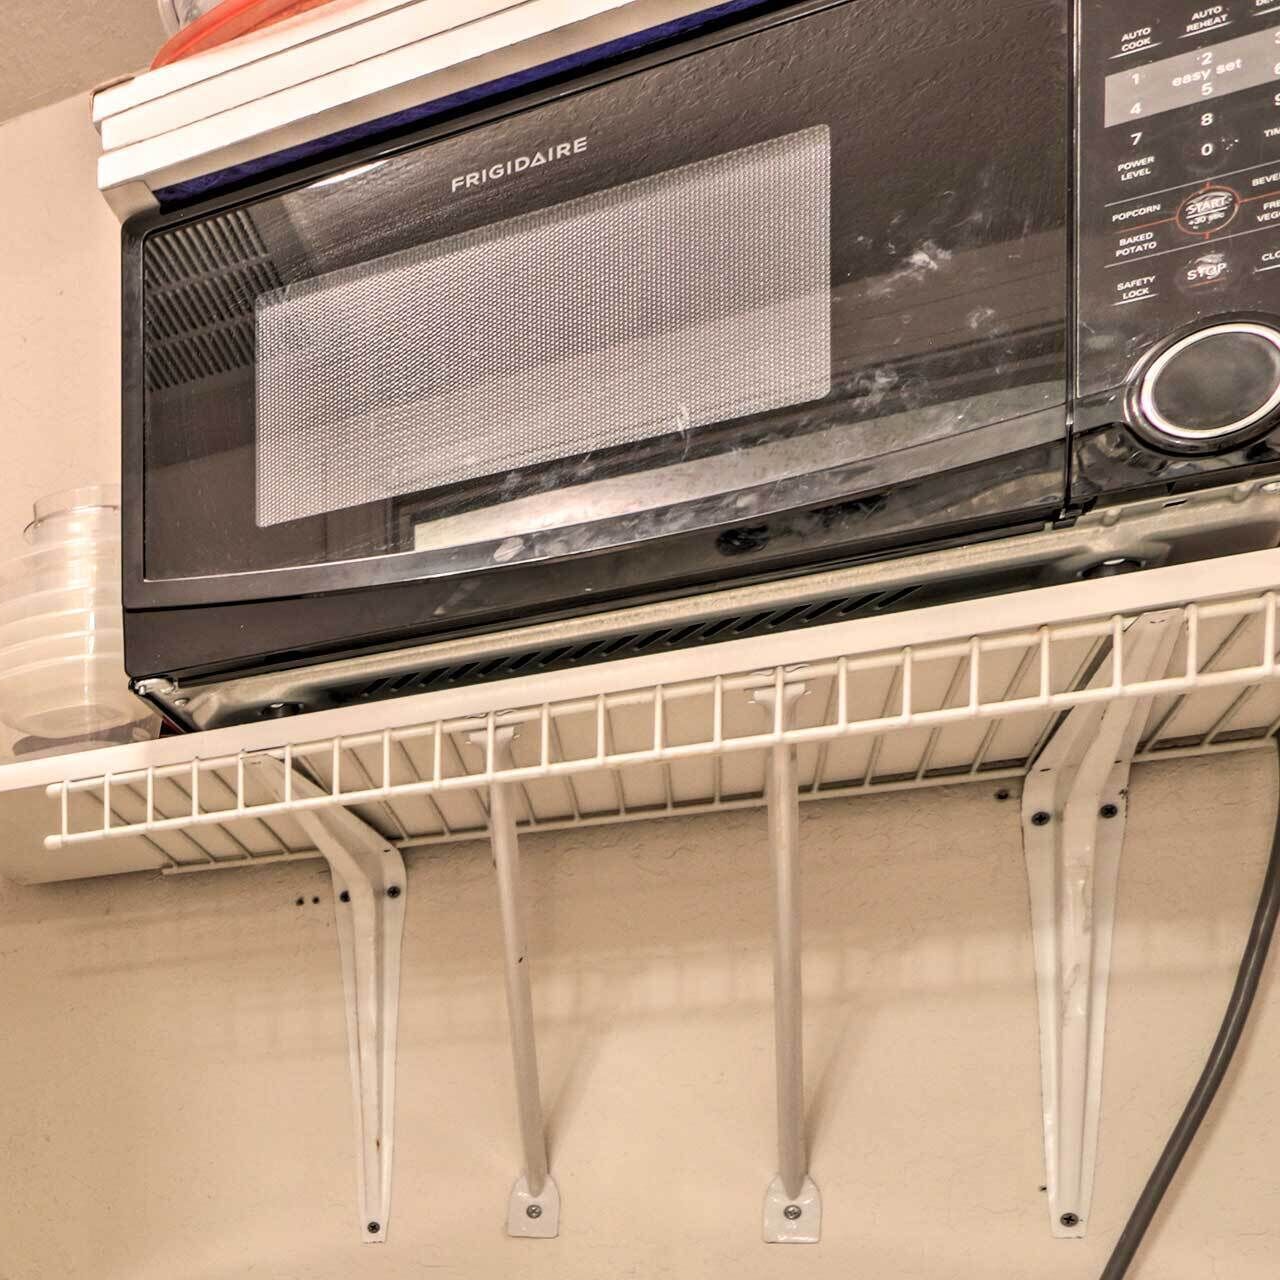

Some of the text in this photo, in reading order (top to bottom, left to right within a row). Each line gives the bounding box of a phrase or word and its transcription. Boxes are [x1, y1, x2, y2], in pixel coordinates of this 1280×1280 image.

[1191, 5, 1223, 21] AUTO
[1186, 13, 1228, 33] REHEAT
[1121, 27, 1151, 42] AUTO
[1122, 37, 1151, 52] COOK
[1201, 52, 1213, 66] 2
[1131, 73, 1140, 86] 1
[1172, 58, 1243, 87] easy set
[1201, 82, 1213, 96] 5
[1130, 102, 1142, 115] 4
[1200, 112, 1214, 126] 8
[1130, 132, 1143, 146] 7
[1201, 143, 1213, 156] 0
[451, 135, 588, 193] FRIGIDAIRE
[1117, 156, 1155, 172] POWER
[1121, 168, 1152, 182] LEVEL
[1112, 203, 1161, 222] POPCORN
[1186, 198, 1228, 215] START
[1119, 232, 1154, 246] BAKED
[1115, 241, 1157, 257] POTATO
[1187, 262, 1228, 281] STOP
[1116, 275, 1156, 291] SAFETY
[1122, 287, 1149, 300] LOCK
